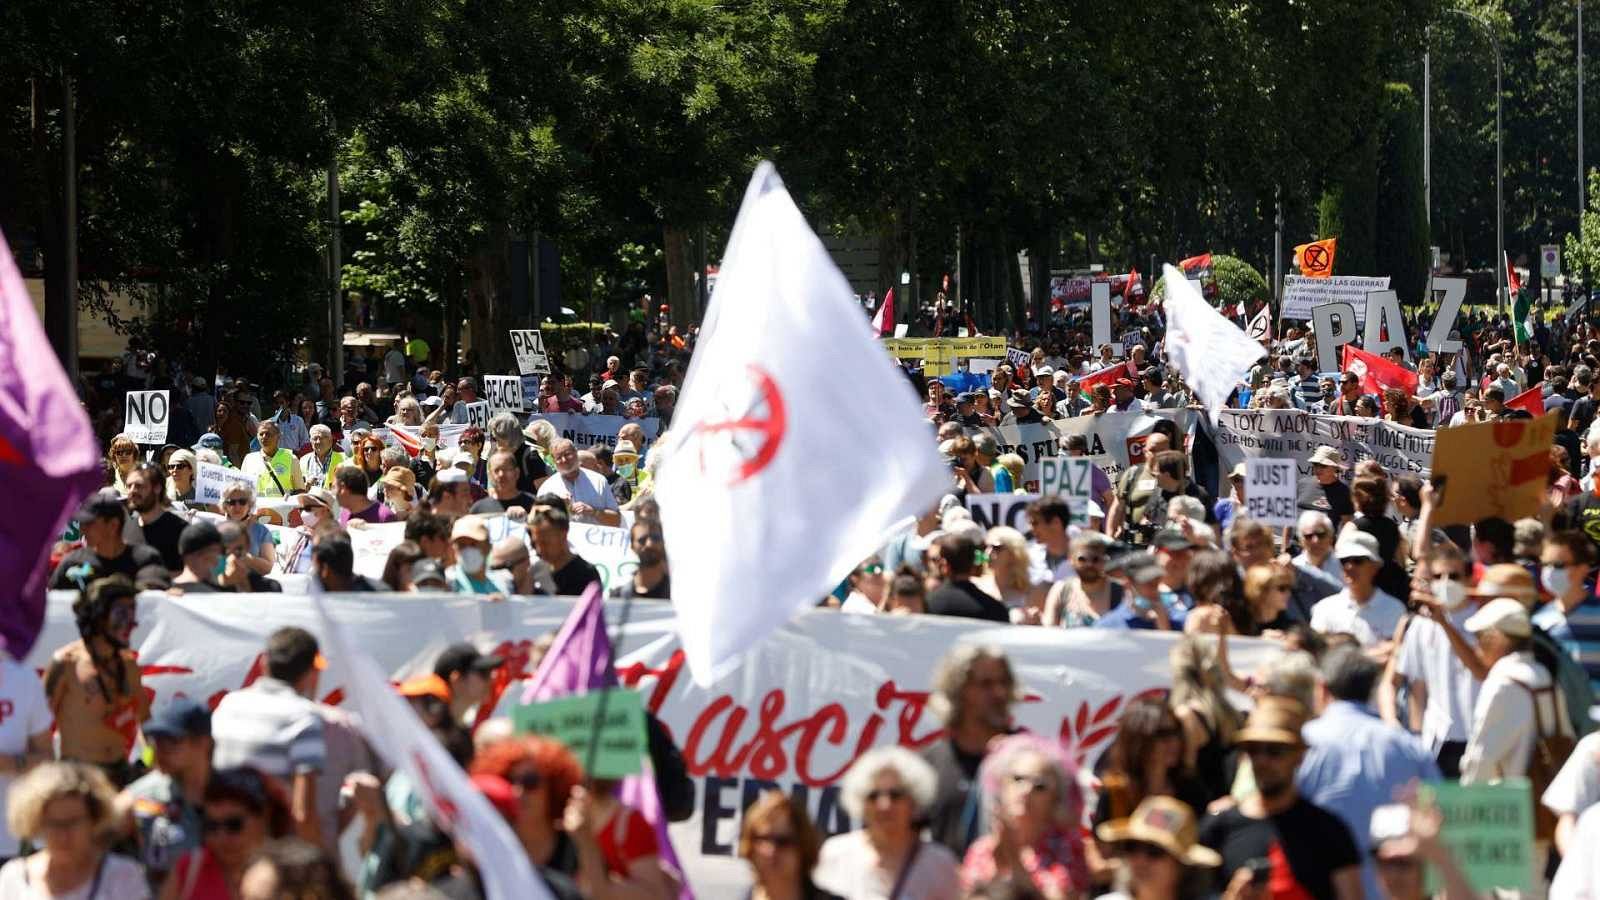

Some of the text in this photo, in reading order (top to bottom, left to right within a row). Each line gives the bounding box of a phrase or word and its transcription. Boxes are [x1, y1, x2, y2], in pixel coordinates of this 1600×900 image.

[1334, 279, 1348, 287] LAS
[1349, 279, 1385, 288] GUERRAS
[510, 331, 545, 357] PAZ
[486, 378, 521, 410] PEACE!
[127, 391, 168, 425] NO
[562, 429, 617, 447] NEITHE
[1042, 460, 1089, 497] PAZ
[1253, 464, 1291, 486] JUST
[1248, 496, 1297, 519] PEACE!
